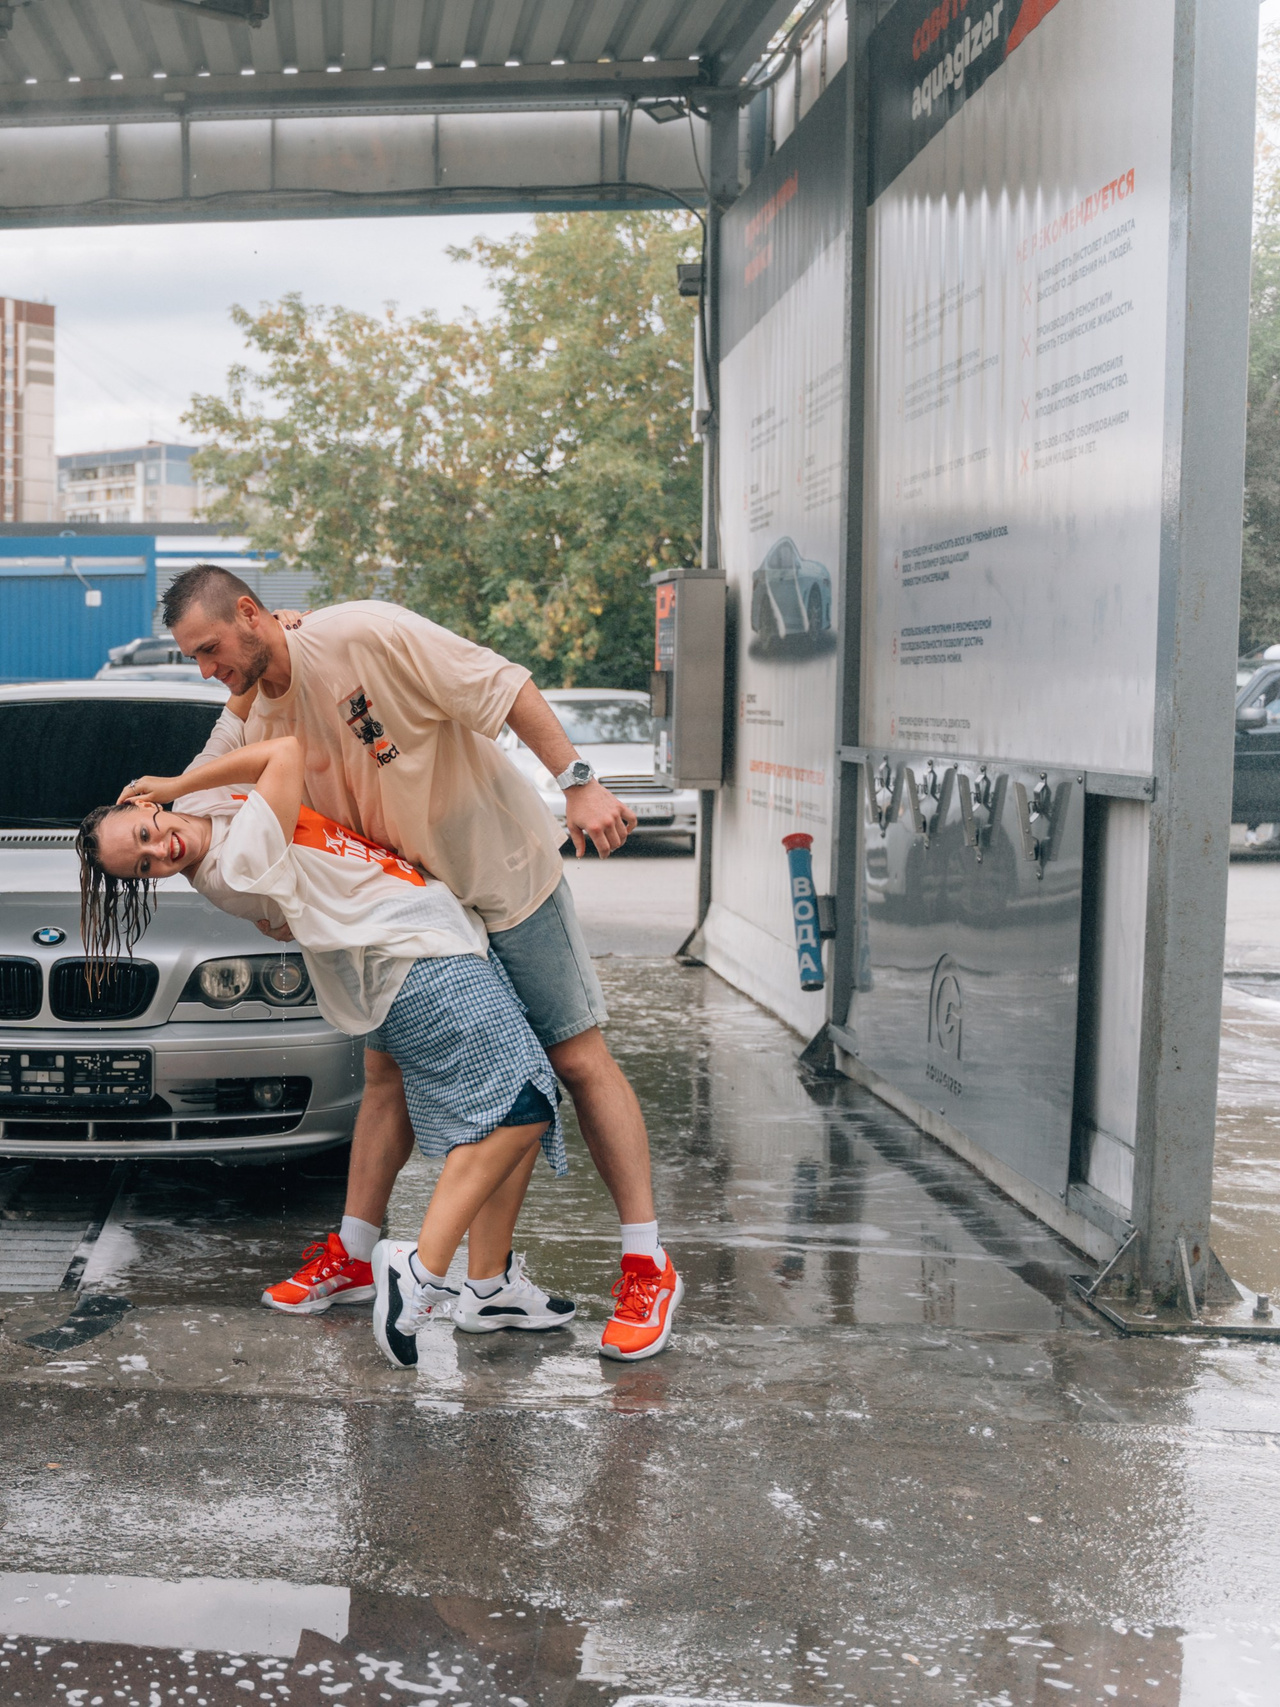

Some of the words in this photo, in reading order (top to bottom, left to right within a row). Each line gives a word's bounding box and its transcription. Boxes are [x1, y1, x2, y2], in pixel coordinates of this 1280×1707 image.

[912, 0, 968, 61] сове
[912, 0, 1004, 120] aquagizer
[1031, 167, 1135, 257] РЕКОМЕНДУЕТСЯ
[1073, 236, 1102, 264] ПИСТОЛЕТ
[1103, 217, 1136, 247] АППАРАТА
[1098, 254, 1107, 268] НА
[1037, 309, 1075, 338] ПРОИЗВОДИТЬ
[1075, 297, 1099, 317] РЕМОНТ
[1099, 290, 1113, 307] ИЛИ
[1057, 317, 1097, 346] ТЕХНИЧЕСКИЕ
[1051, 373, 1081, 397] ДВИГАТЕЛЬ
[1082, 354, 1124, 383] АВТОМОБИЛЯ
[1076, 410, 1130, 439] ОБОРУДОВАНИЕМ
[376, 743, 400, 768] fect
[793, 876, 818, 973] ВОДА
